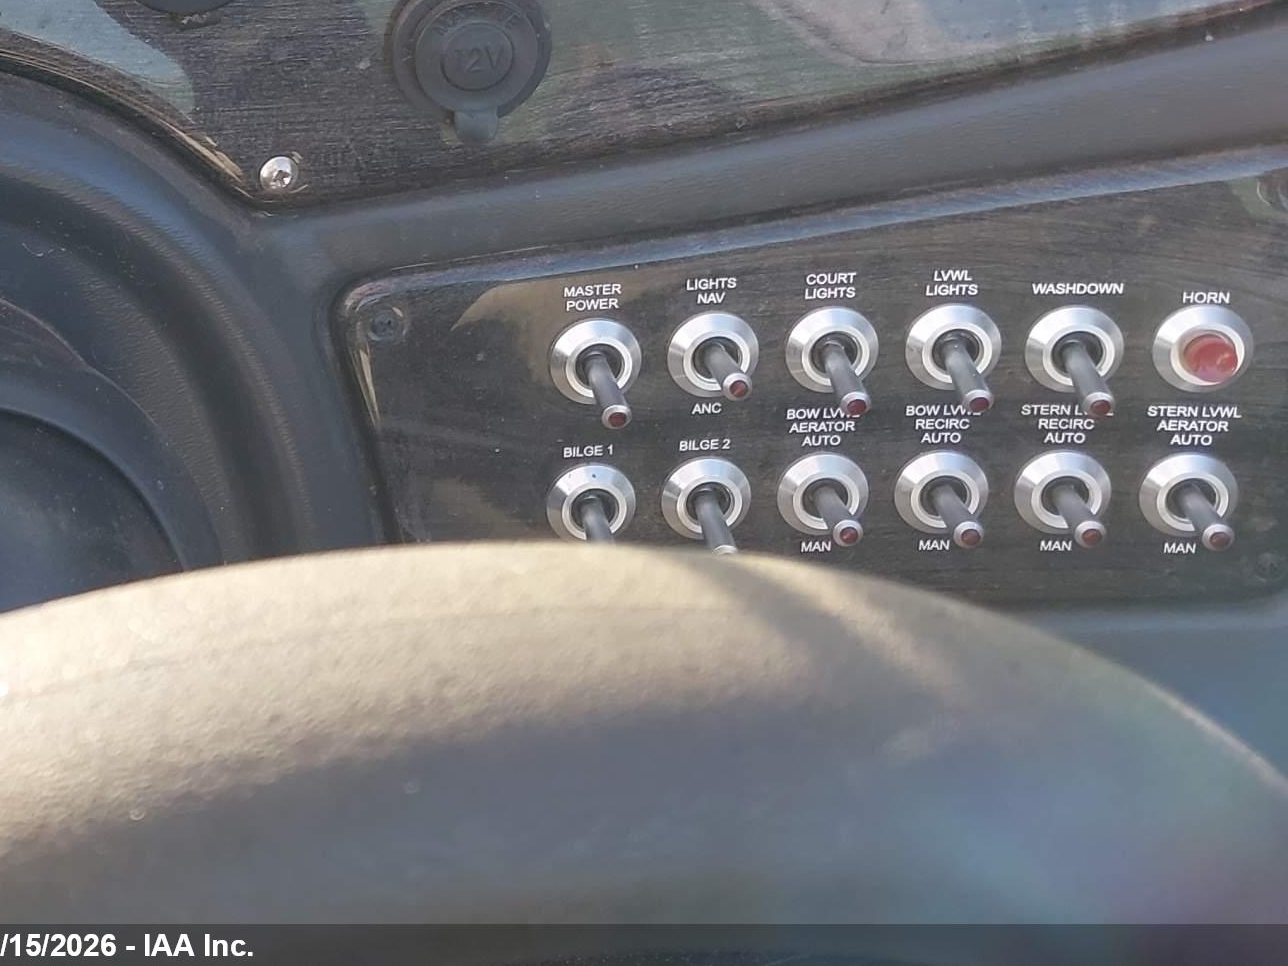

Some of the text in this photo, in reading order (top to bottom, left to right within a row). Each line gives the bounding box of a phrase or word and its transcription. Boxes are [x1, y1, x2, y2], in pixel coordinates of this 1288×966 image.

[806, 272, 857, 285] COURT
[933, 269, 973, 282] LVWL
[563, 283, 622, 297] MASTER
[686, 277, 737, 291] LIGHTS
[925, 284, 978, 296] LIGHTS
[1032, 282, 1124, 295] WASHDOWN
[697, 292, 726, 304] NAV
[804, 286, 856, 300] LIGHTS
[1182, 291, 1231, 304] HORN
[566, 298, 619, 312] POWER
[691, 402, 722, 415] ANC
[786, 407, 860, 421] BOW LV
[905, 404, 982, 417] BOW LV
[1020, 404, 1072, 416] STERN
[1147, 405, 1242, 419] STERN LVWL
[789, 420, 856, 433] AERATOR
[915, 418, 970, 430] RECIRC
[1038, 418, 1095, 430] RECIRC
[1156, 420, 1229, 432] AERATOR
[679, 438, 731, 451] BILGE 2
[801, 434, 841, 447] AUTO
[920, 432, 962, 444] AUTO
[1043, 432, 1086, 444] AUTO
[1170, 433, 1213, 446] AUTO
[563, 444, 614, 458] BILGE 1
[800, 540, 832, 553] MAN
[918, 539, 950, 551] MAN
[1039, 540, 1072, 551] MAN
[1163, 542, 1197, 554] MAN
